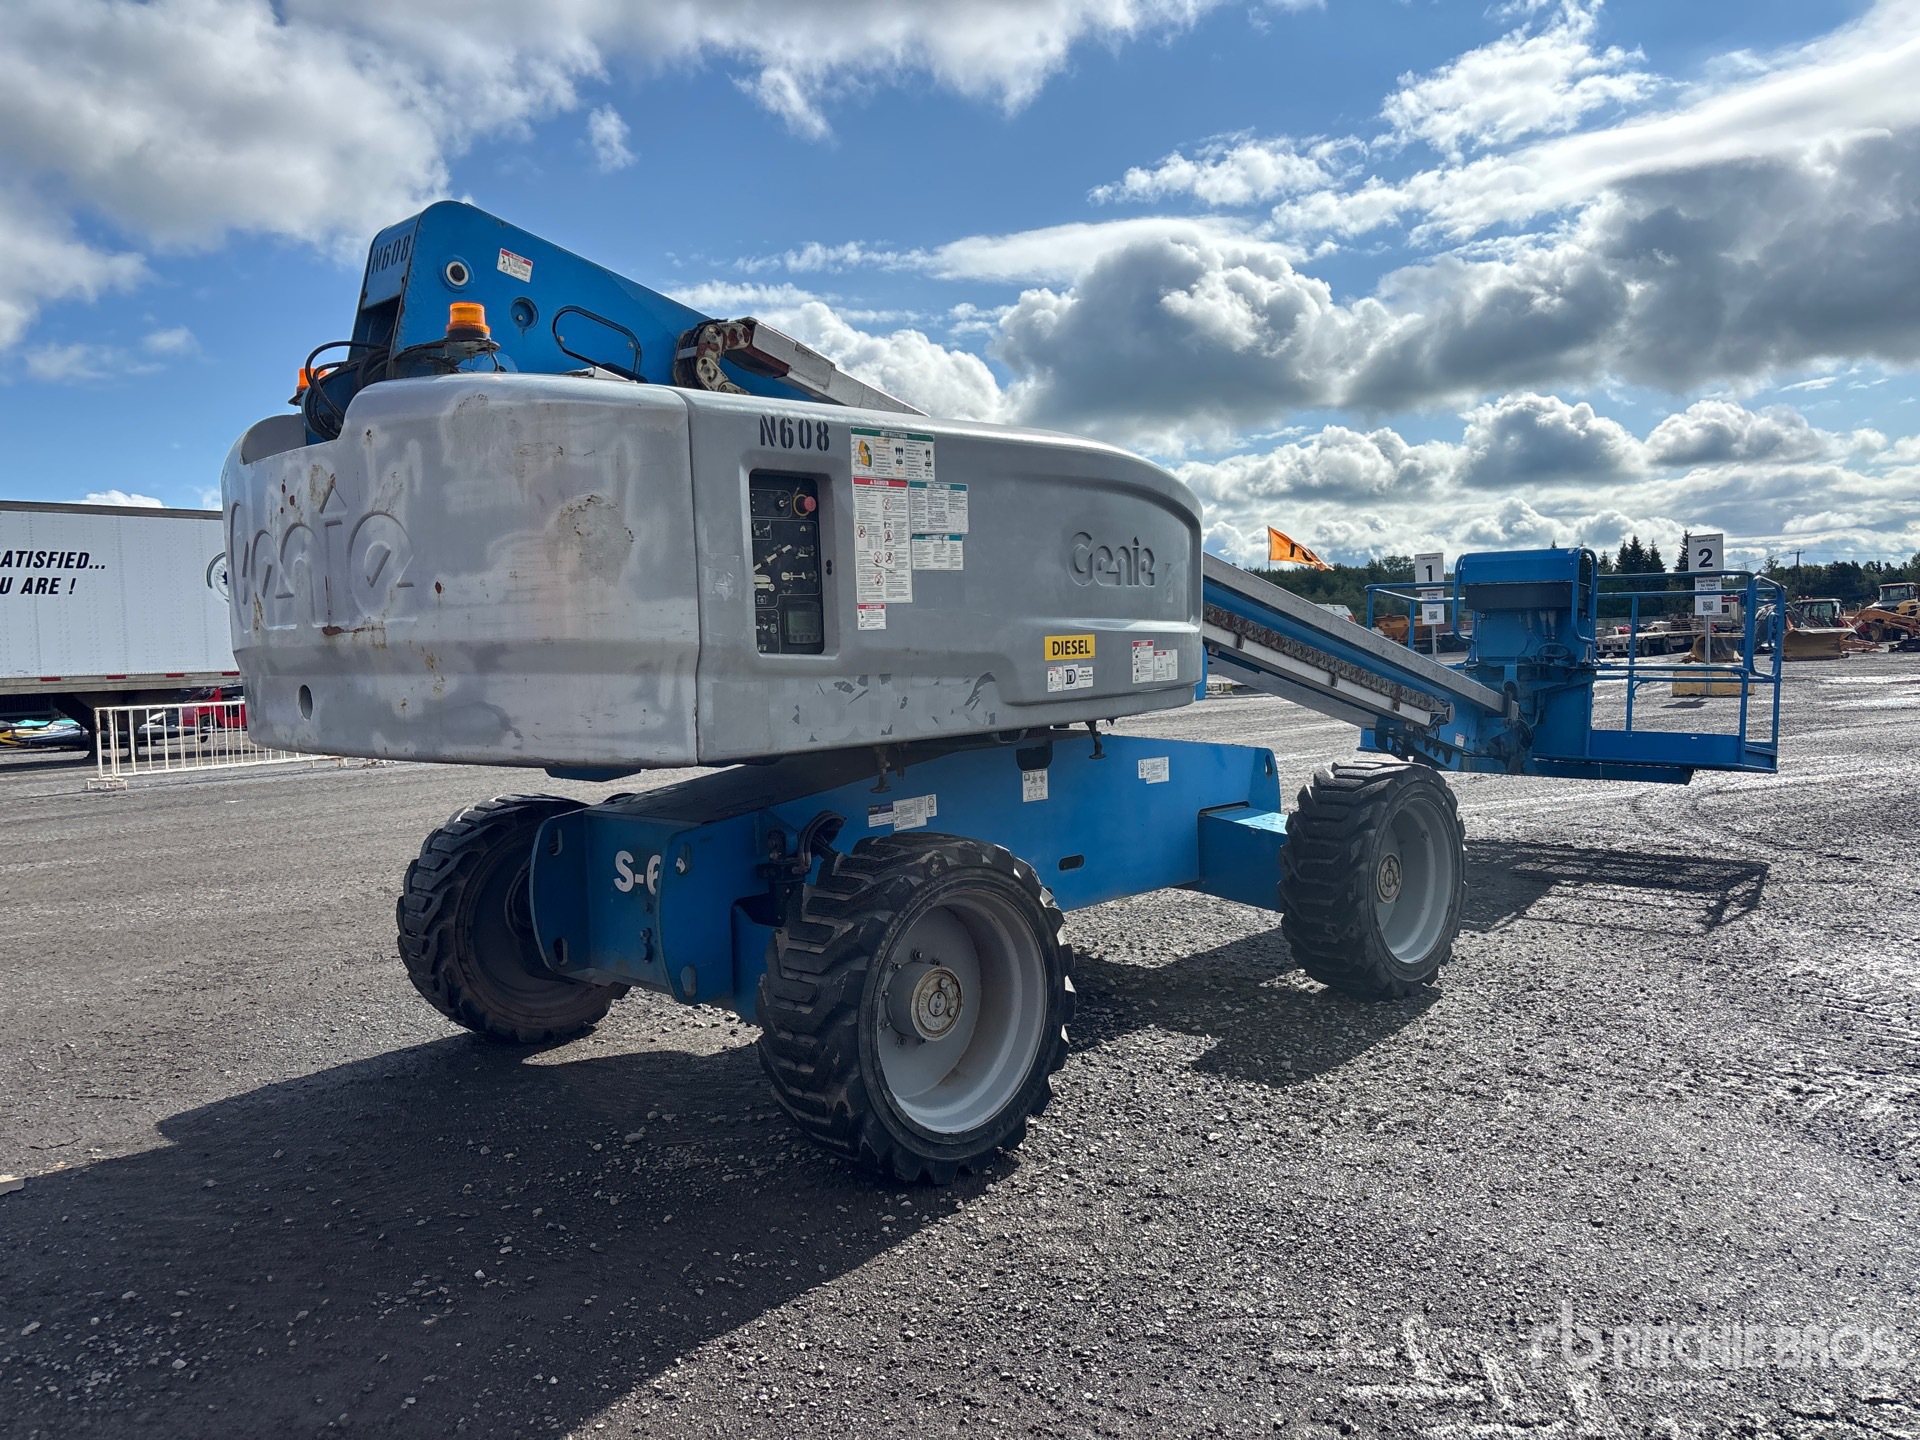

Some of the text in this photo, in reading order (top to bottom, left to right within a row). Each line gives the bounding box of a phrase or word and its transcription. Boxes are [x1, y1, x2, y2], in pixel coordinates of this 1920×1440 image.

[371, 235, 411, 275] N608
[760, 415, 830, 452] N608
[0, 550, 106, 570] ATISFIED...
[1068, 531, 1156, 587] Genie
[1698, 548, 1713, 568] 2
[1425, 564, 1433, 582] 1
[20, 577, 61, 595] ARE
[69, 577, 77, 595] !
[1052, 640, 1091, 656] DIESEL
